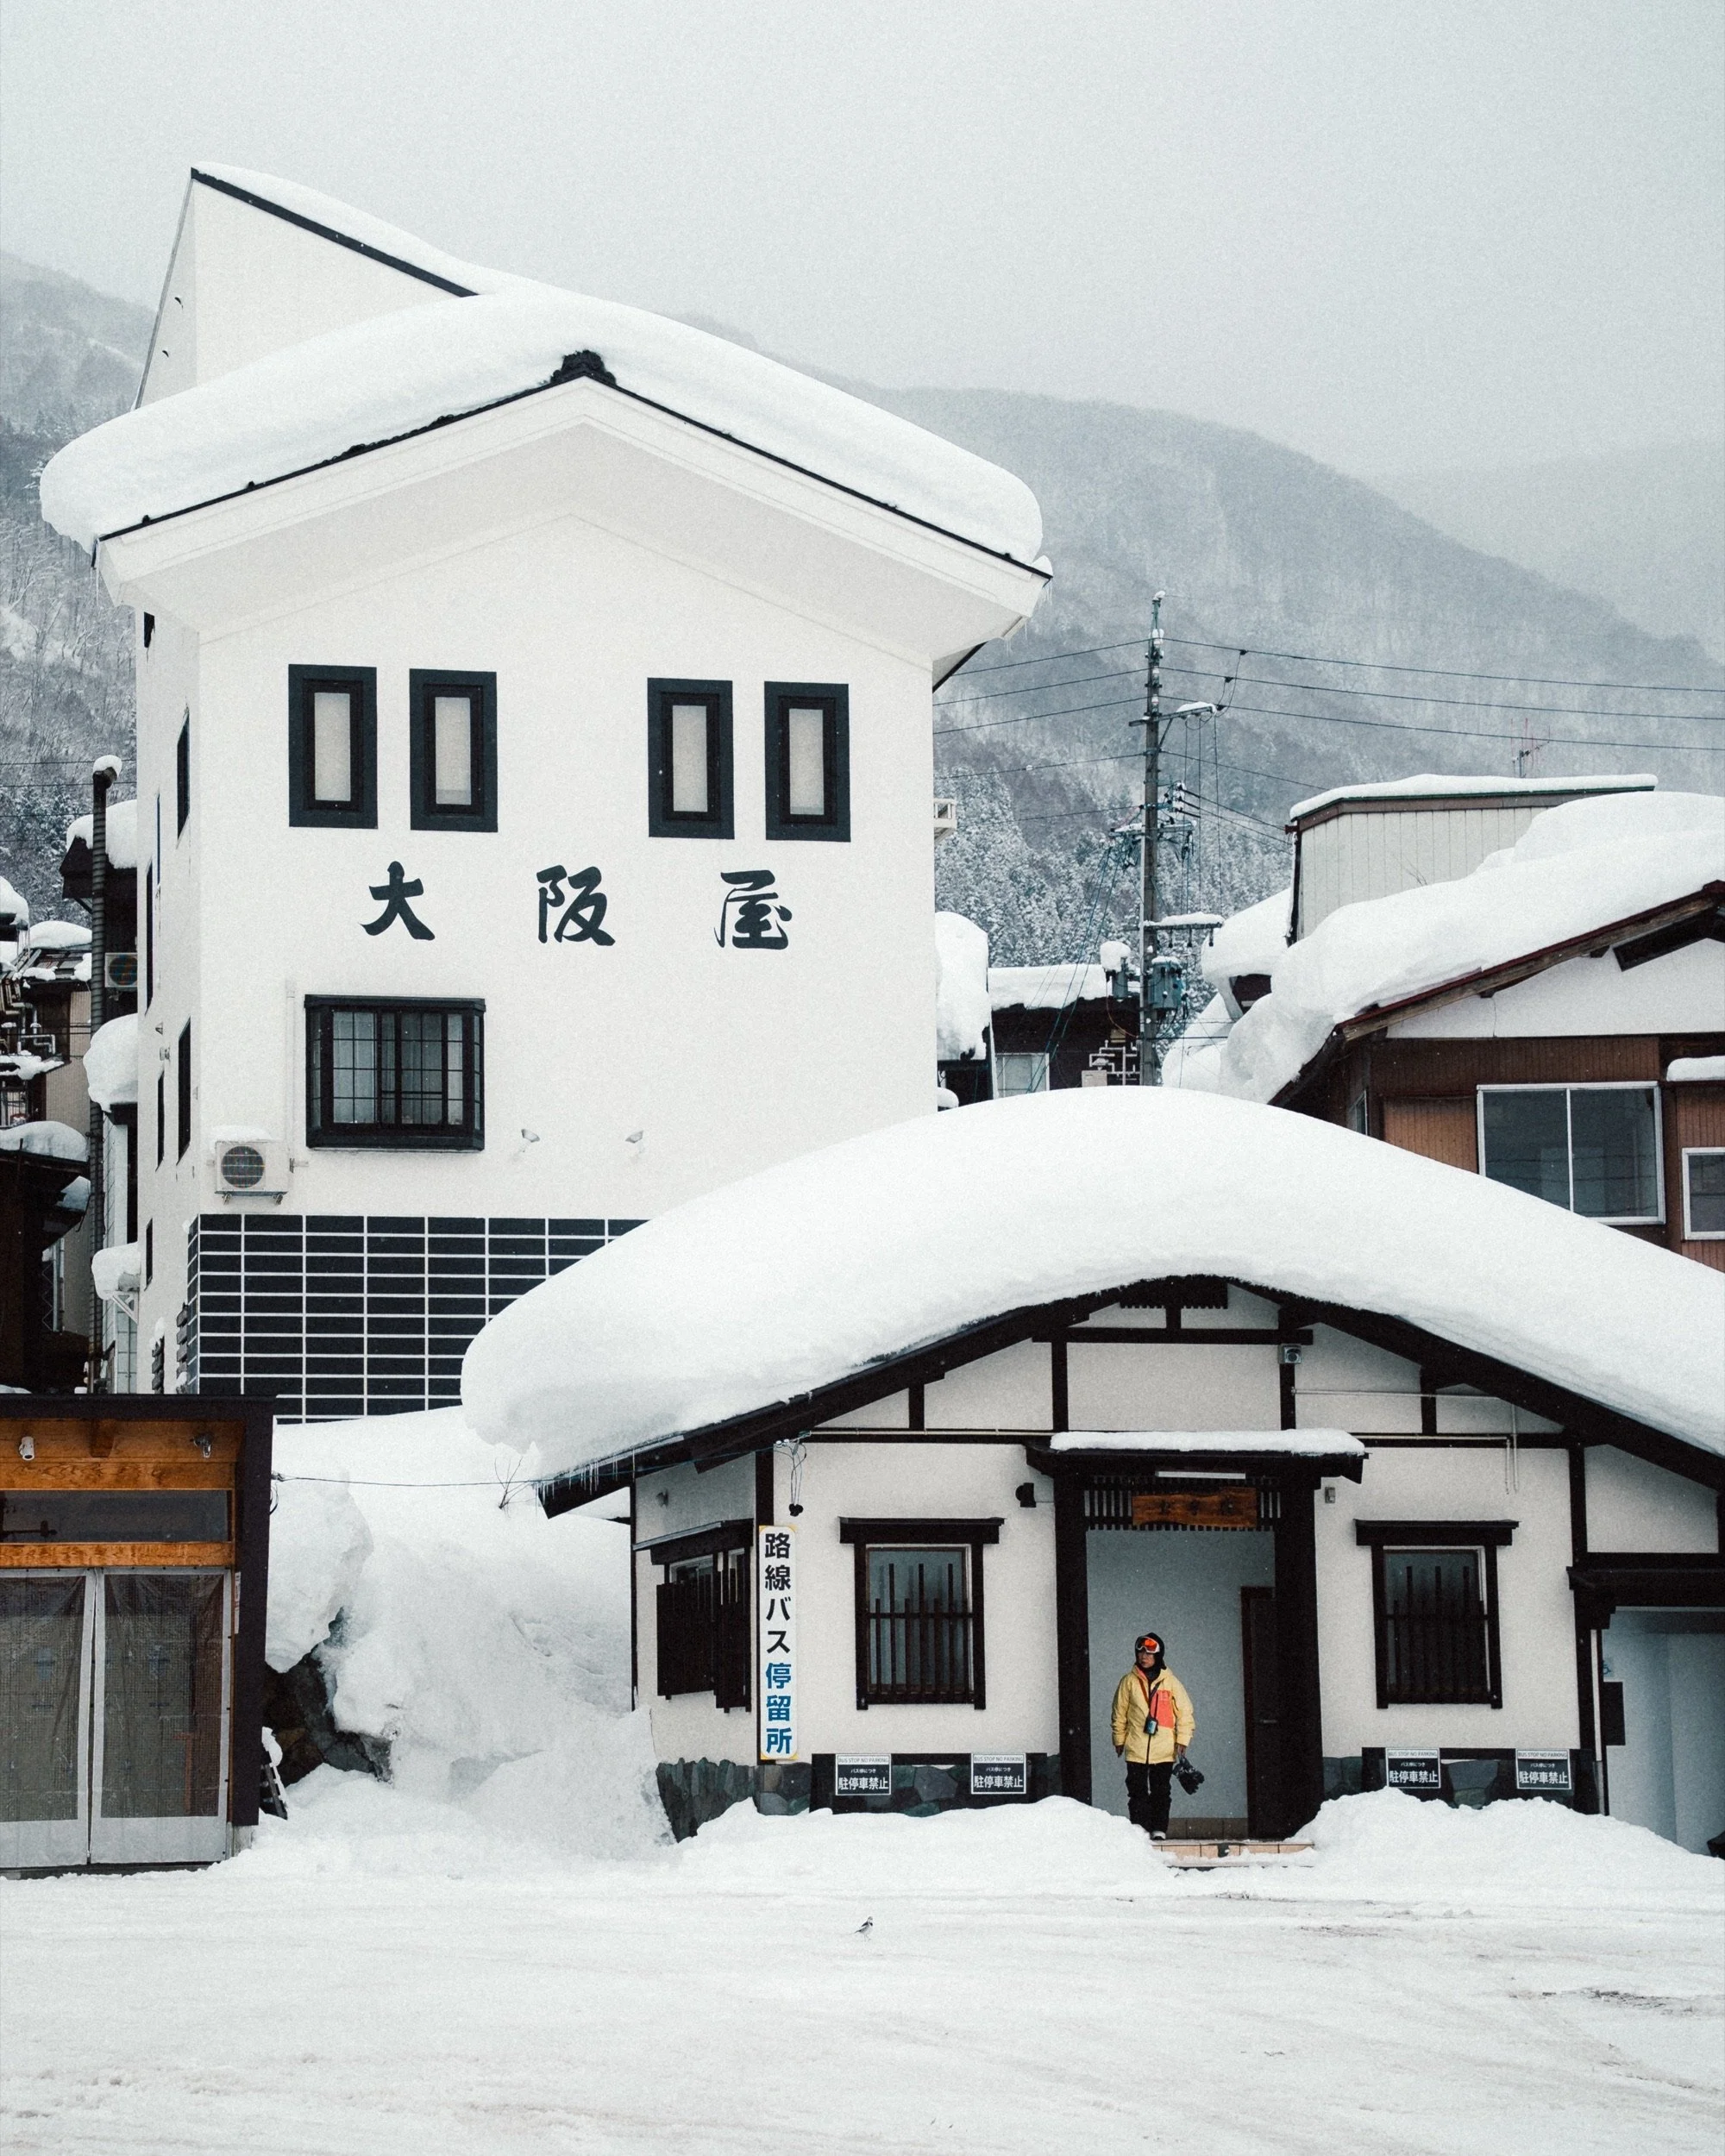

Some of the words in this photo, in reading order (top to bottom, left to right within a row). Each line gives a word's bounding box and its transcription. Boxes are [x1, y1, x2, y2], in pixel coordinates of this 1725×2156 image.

[359, 860, 793, 950] 大阪屋
[764, 1532, 793, 1754] 路線バス停留所
[837, 1777, 889, 1790] 駐停車禁止
[974, 1775, 1024, 1789] 駐停車禁止
[1389, 1771, 1439, 1783] 駐停車禁止
[1519, 1771, 1569, 1784] 駐停車禁止
